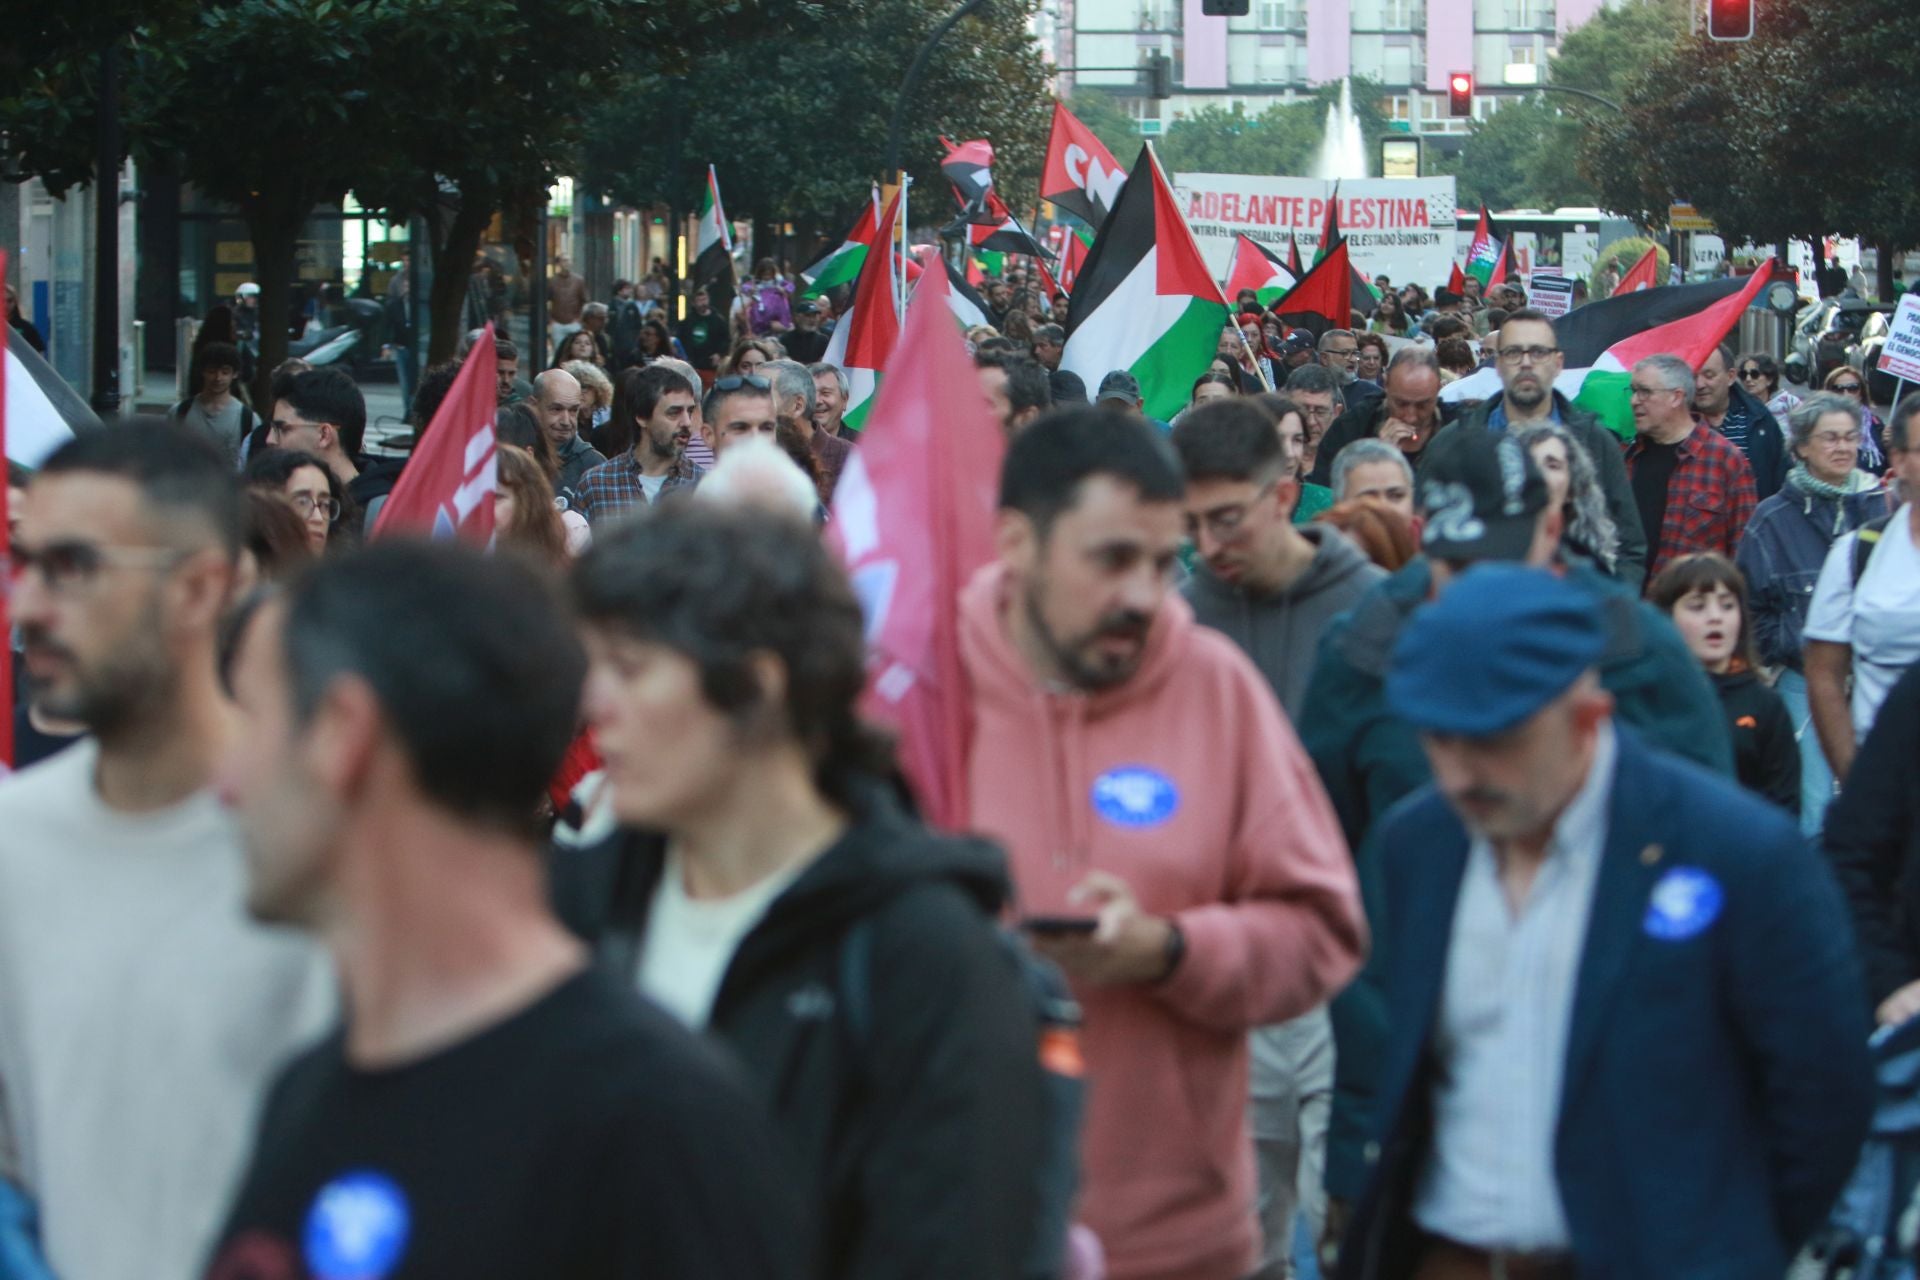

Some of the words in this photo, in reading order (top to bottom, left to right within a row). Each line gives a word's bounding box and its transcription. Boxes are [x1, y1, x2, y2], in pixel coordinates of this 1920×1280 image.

[1188, 191, 1304, 228] ADELANTE
[1308, 197, 1429, 230] PLESTINA
[1350, 234, 1360, 247] EL
[1361, 233, 1396, 247] ESTADO
[1397, 231, 1441, 246] SIONISTA
